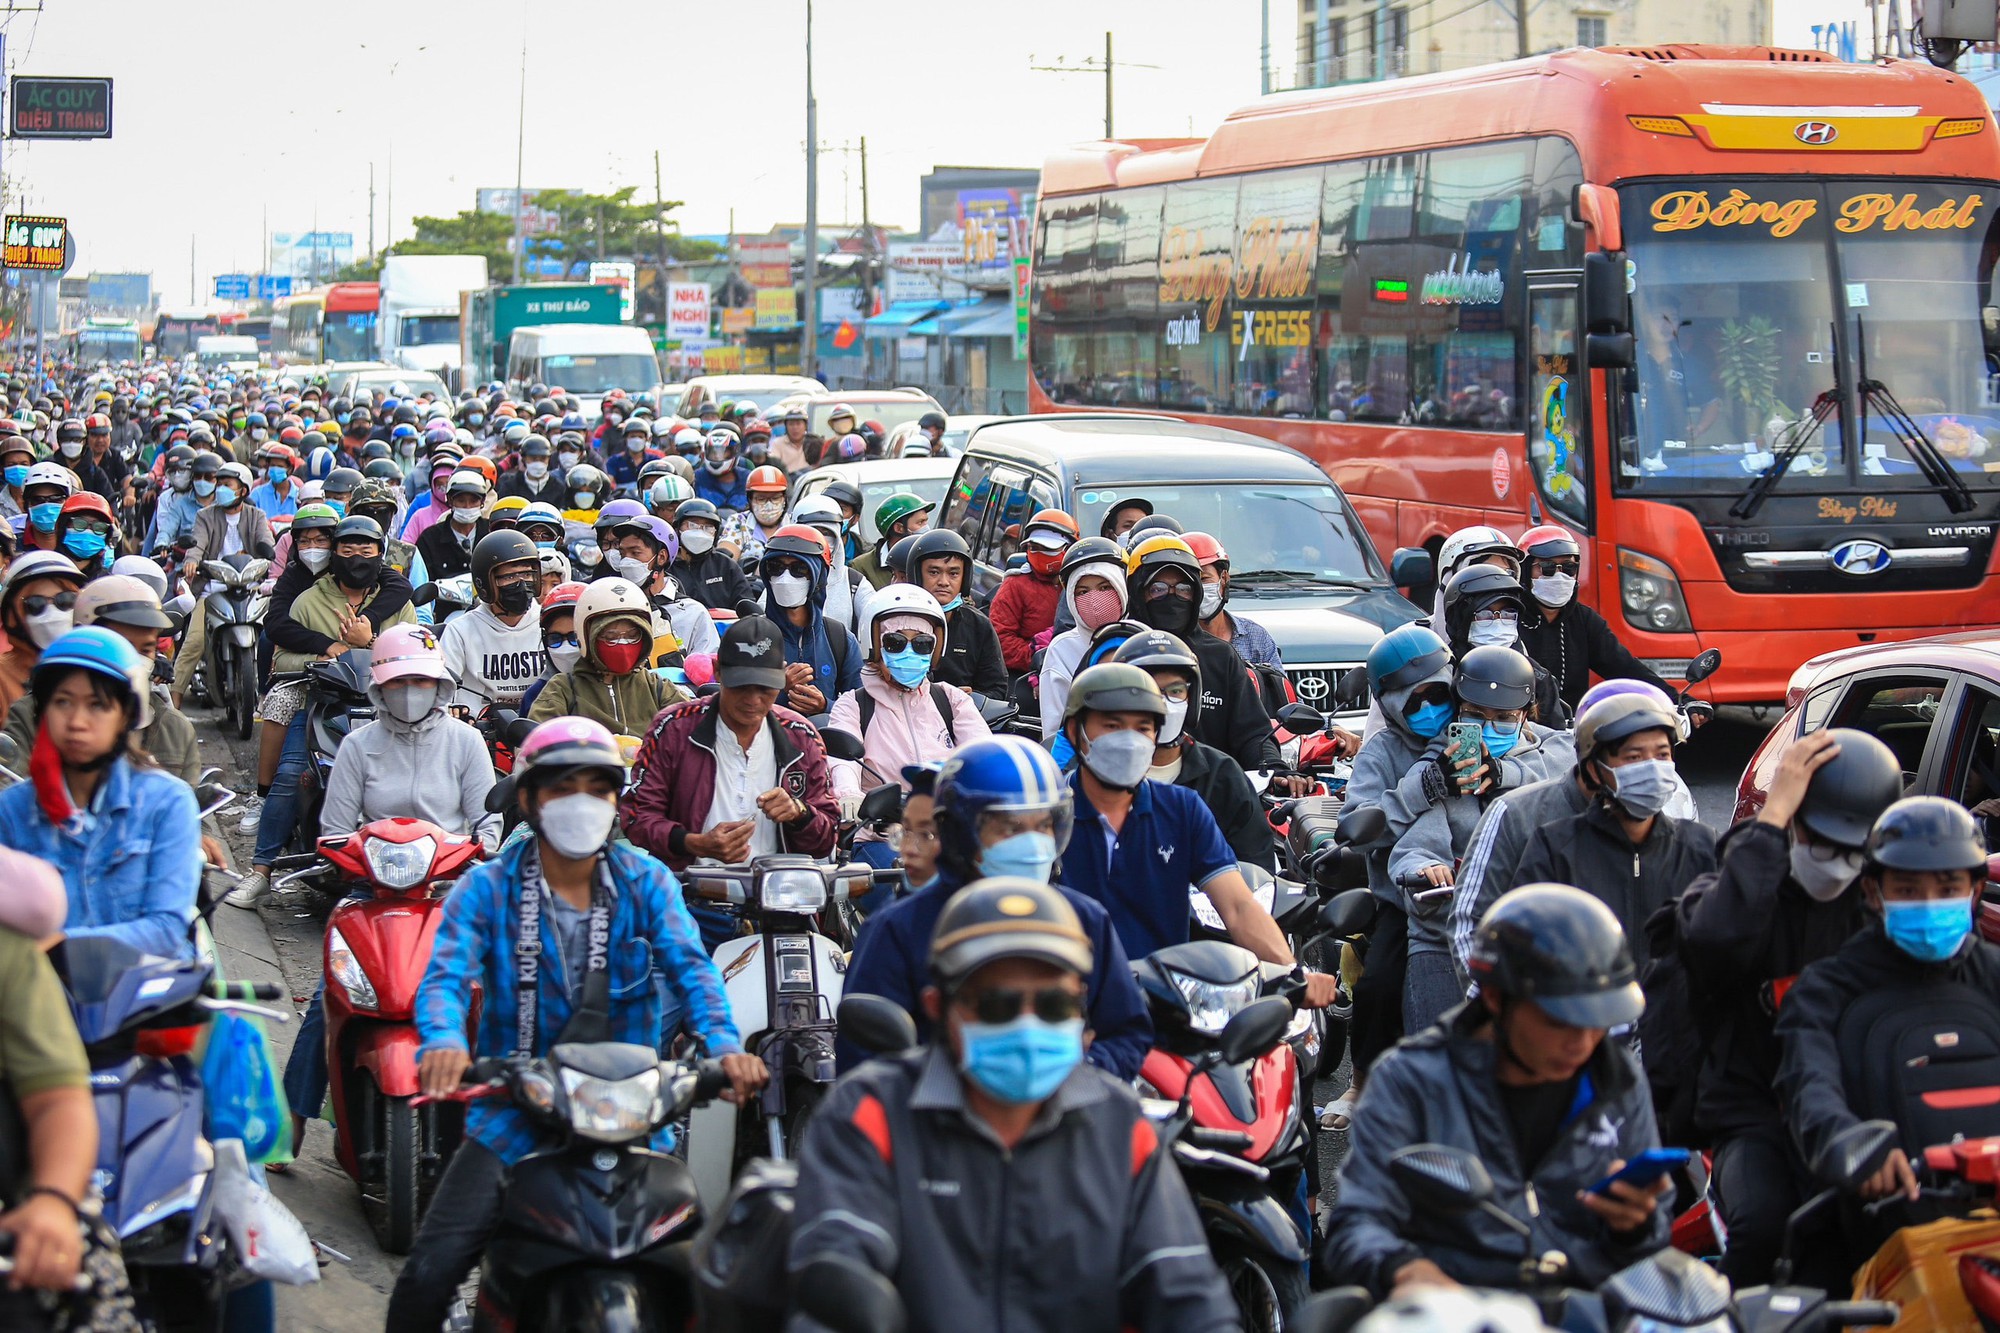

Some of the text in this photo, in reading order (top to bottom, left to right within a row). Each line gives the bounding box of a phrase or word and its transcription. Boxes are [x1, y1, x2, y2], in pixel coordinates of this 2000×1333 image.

[56, 88, 97, 108] QUY
[57, 110, 105, 129] TRANG
[1650, 188, 1983, 237] Đồng Phát
[33, 226, 63, 248] QUY
[1232, 310, 1311, 361] EXPRESS
[1928, 526, 1991, 539] HYUNDAI
